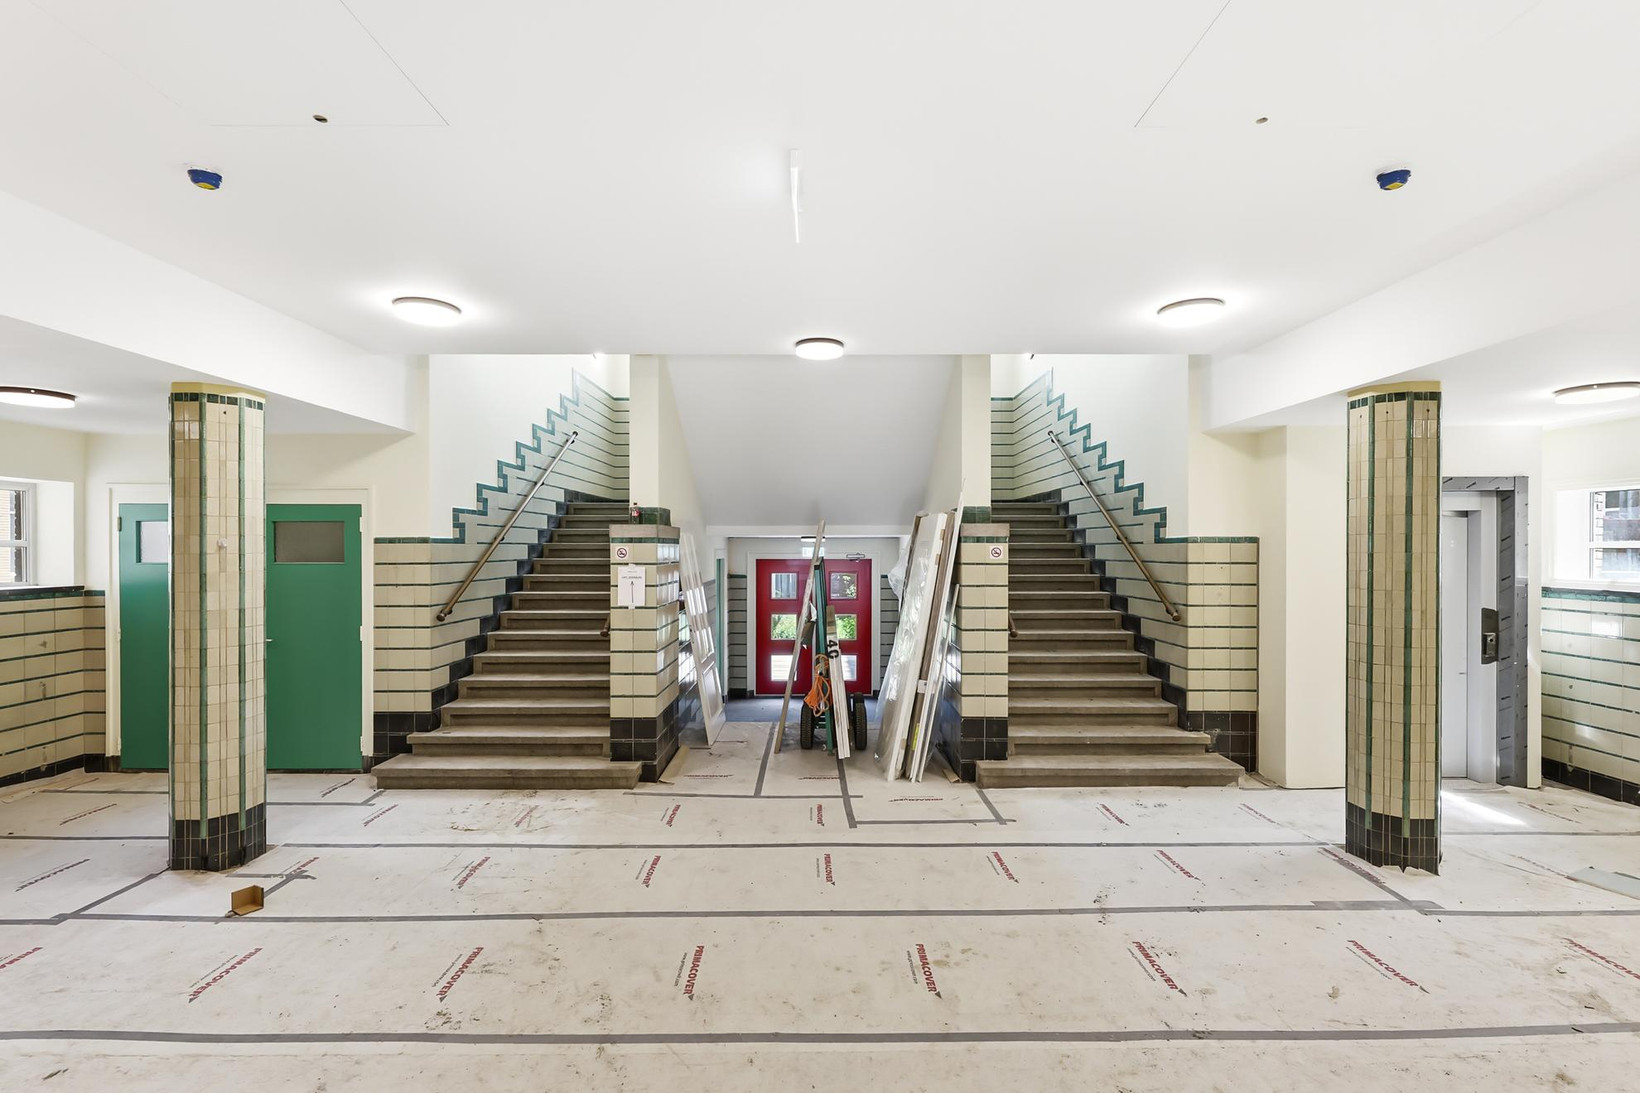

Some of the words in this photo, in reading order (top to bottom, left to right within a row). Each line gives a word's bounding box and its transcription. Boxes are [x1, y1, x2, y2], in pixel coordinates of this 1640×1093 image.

[823, 853, 833, 883] PRIMACOVER
[189, 947, 262, 999] PRIMACOVER
[436, 946, 483, 997] PRIMACOVER
[683, 945, 704, 996] PRIMACOVER
[916, 943, 937, 993] PRIMACOVER
[1132, 940, 1178, 990] PRIMACOVER
[1347, 939, 1417, 986] PRIMACOVER
